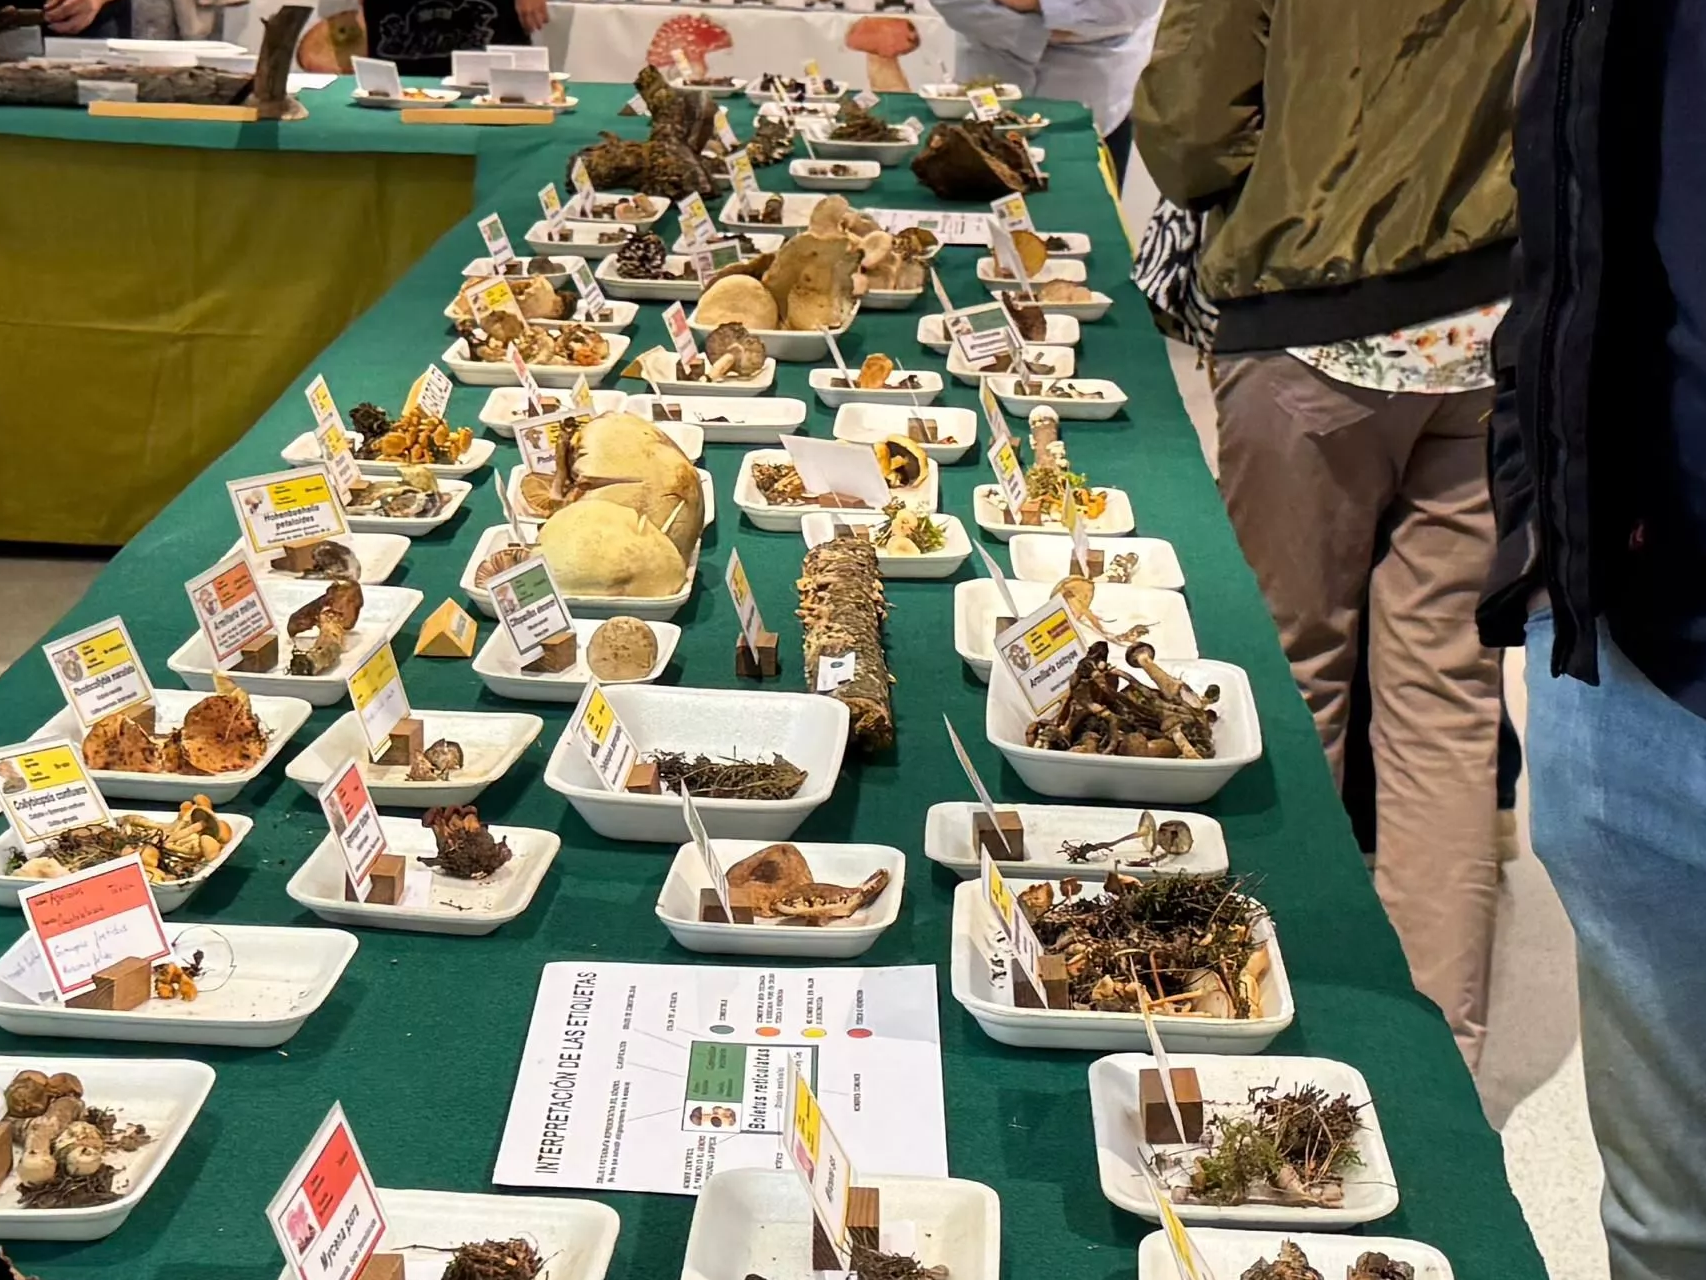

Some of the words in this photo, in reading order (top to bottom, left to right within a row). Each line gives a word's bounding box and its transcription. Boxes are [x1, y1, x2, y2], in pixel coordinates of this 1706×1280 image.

[567, 971, 597, 1027] ETIQUETAS
[563, 1029, 586, 1050] LAS
[558, 1053, 581, 1069] DE
[535, 1071, 578, 1174] INTERPRETACIÓN
